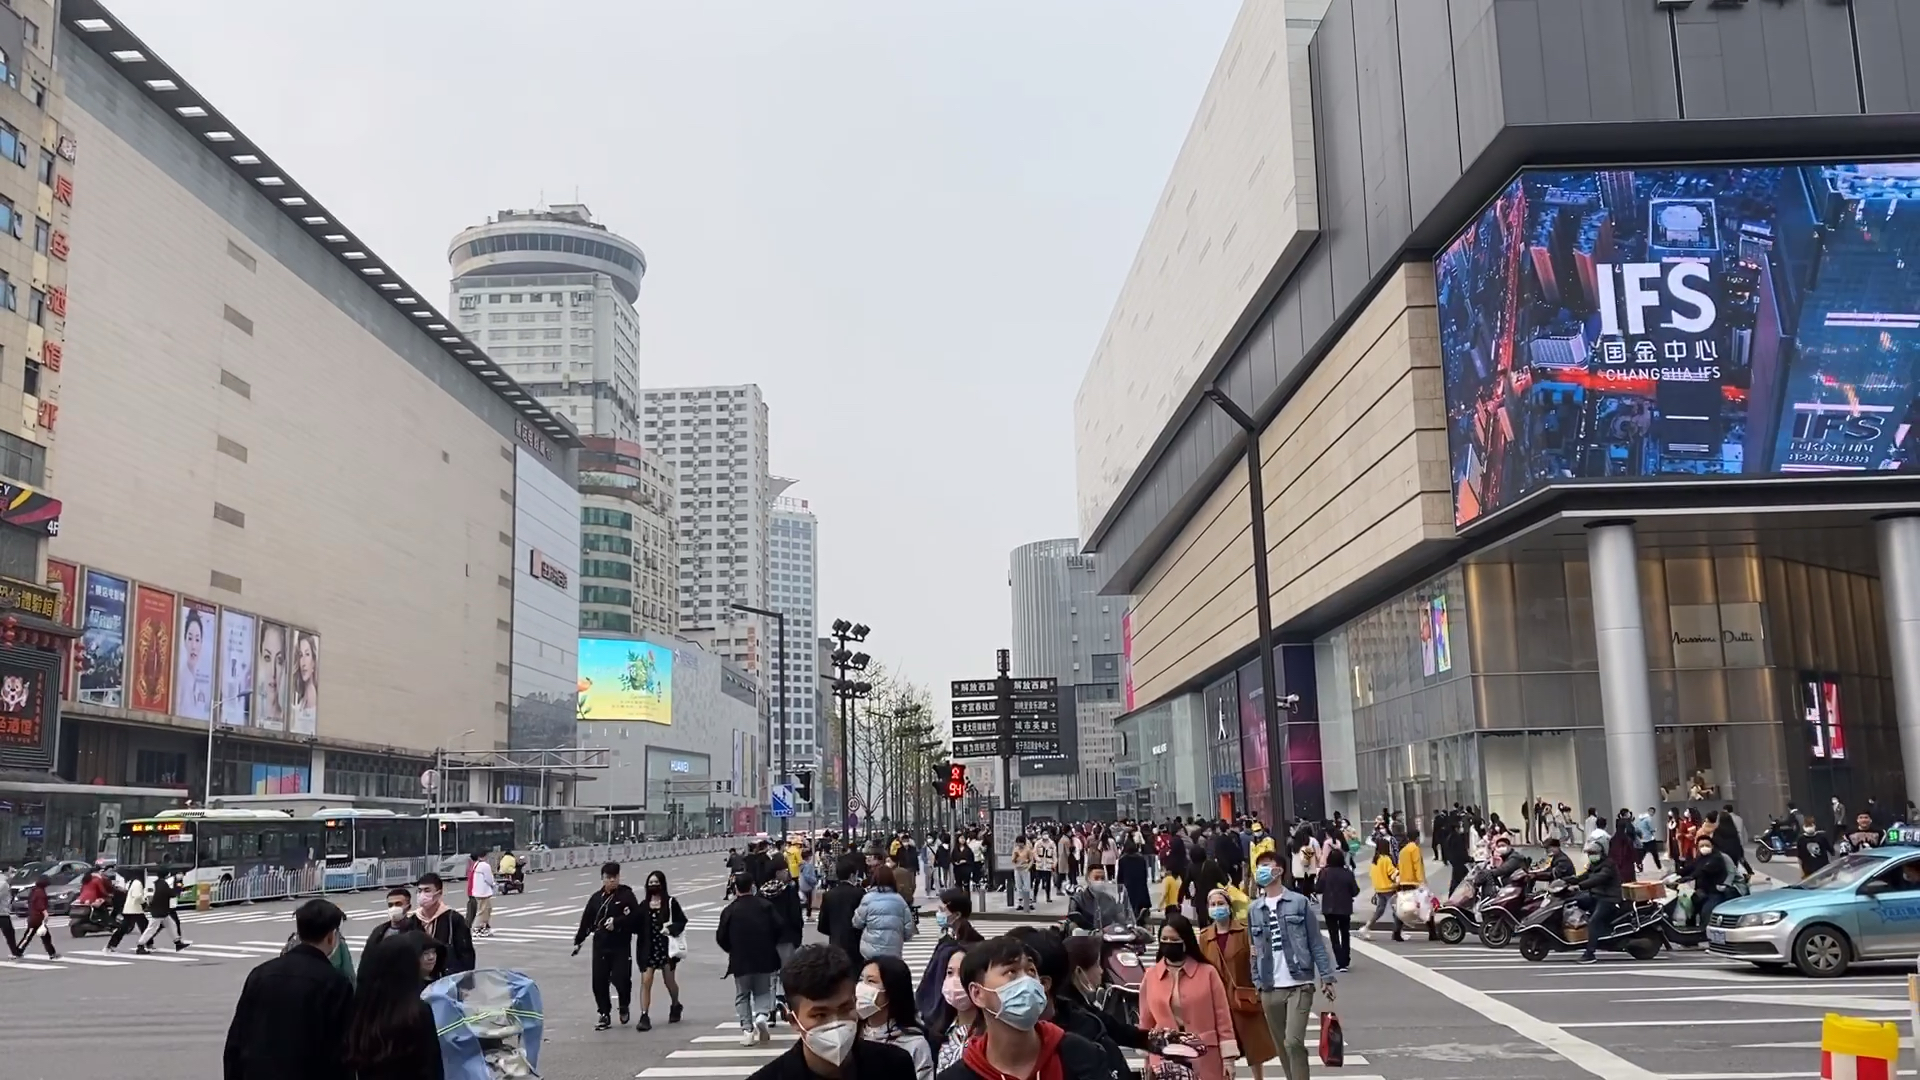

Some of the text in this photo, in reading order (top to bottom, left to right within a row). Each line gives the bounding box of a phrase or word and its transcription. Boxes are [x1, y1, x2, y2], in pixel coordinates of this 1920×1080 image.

[1596, 262, 1717, 335] IFS
[1603, 340, 1718, 364] 国金中心
[1605, 366, 1721, 382] CHANGSHA IFS
